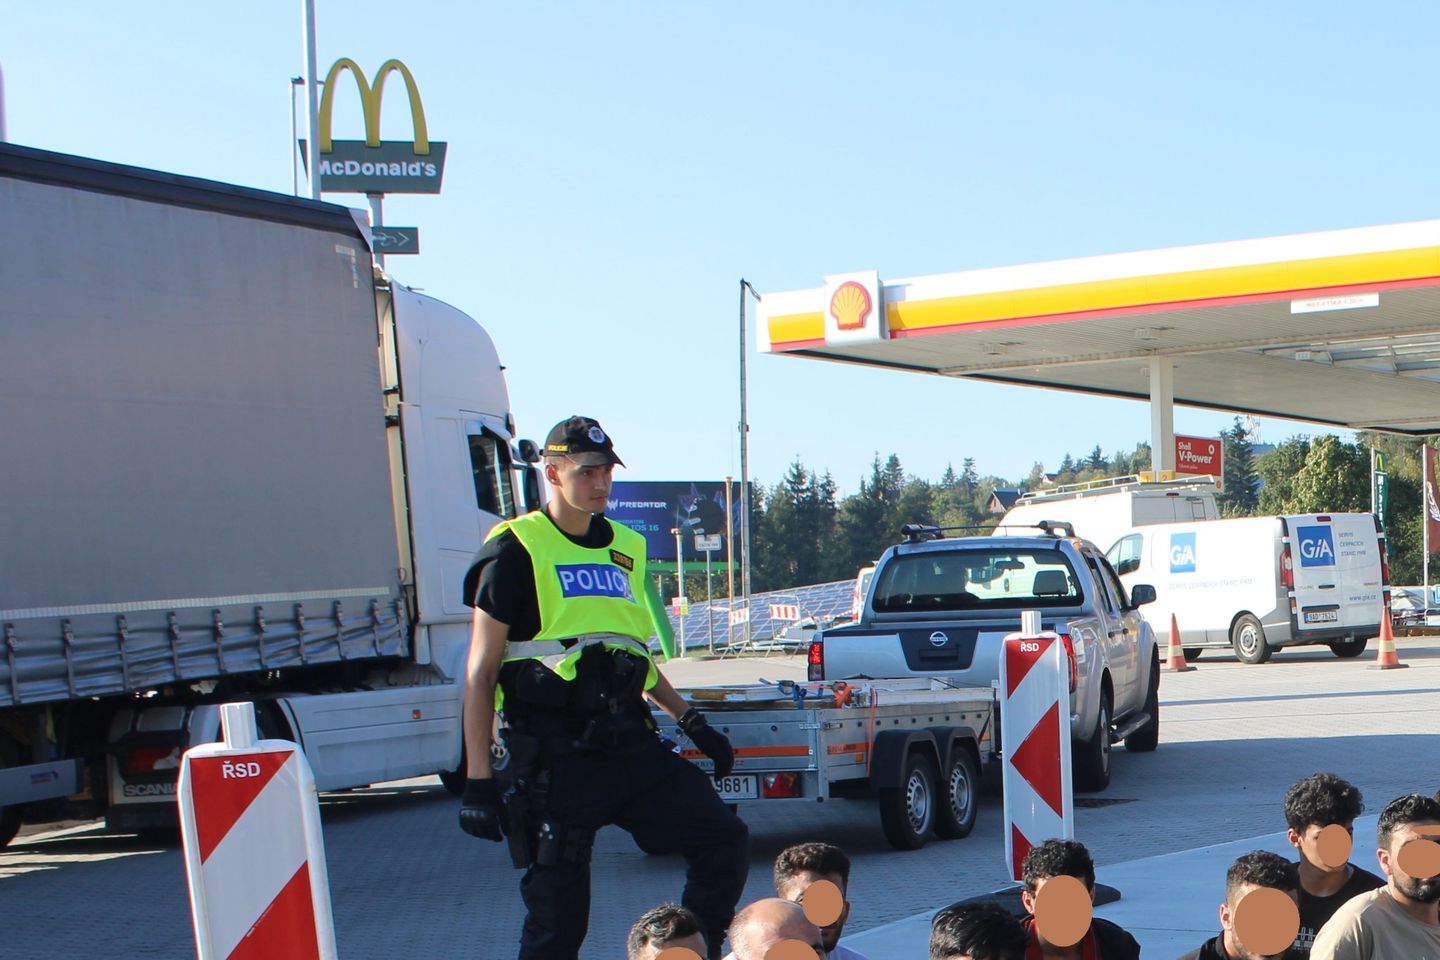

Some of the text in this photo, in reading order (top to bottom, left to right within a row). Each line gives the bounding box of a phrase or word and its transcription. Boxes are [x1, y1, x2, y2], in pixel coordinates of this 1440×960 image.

[319, 160, 437, 177] McDonald's
[1178, 441, 1192, 450] Shell
[1178, 451, 1213, 464] V-Power
[619, 501, 668, 510] PREDATOR
[1020, 641, 1040, 653] ŘSD
[222, 760, 261, 779] ŘSD
[715, 777, 749, 793] 9681
